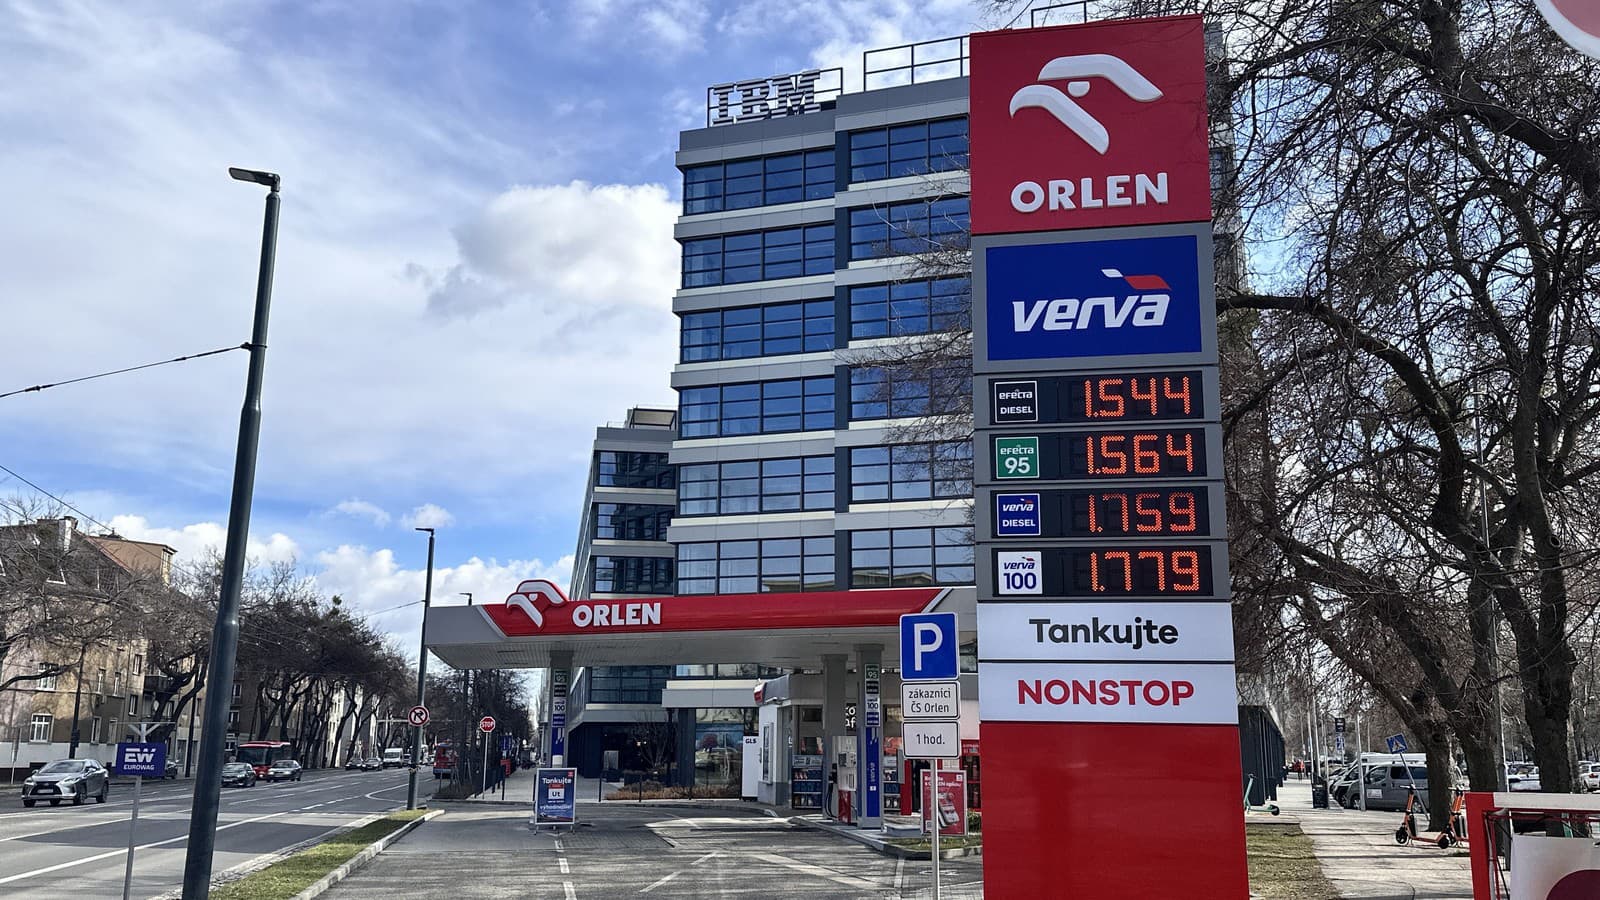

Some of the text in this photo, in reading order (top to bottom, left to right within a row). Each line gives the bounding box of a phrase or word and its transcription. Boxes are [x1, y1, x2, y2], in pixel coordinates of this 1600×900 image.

[713, 70, 820, 126] IBM
[1010, 172, 1169, 213] ORLEN
[1012, 294, 1171, 332] verva
[1084, 376, 1191, 418] 1.544
[1000, 406, 1033, 415] DIESEL
[1086, 433, 1194, 475] 1.564
[1004, 457, 1031, 474] 95
[1002, 503, 1034, 512] verva
[1088, 491, 1196, 533] 1.759
[1002, 519, 1036, 527] DIESEL
[1003, 562, 1035, 570] verva
[1090, 551, 1199, 592] 1.779
[1003, 572, 1037, 590] 100
[572, 602, 661, 628] ORLEN
[1028, 617, 1179, 650] Tankujte
[913, 622, 943, 671] P
[908, 687, 951, 699] zákazníci
[1017, 679, 1195, 706] NONSTOP
[554, 704, 566, 712] 100
[867, 702, 879, 710] 100
[911, 701, 922, 713] ČS
[924, 702, 949, 713] Orlen
[916, 734, 945, 745] 1 hod.
[124, 747, 156, 763] EW
[541, 777, 572, 785] Tankujte
